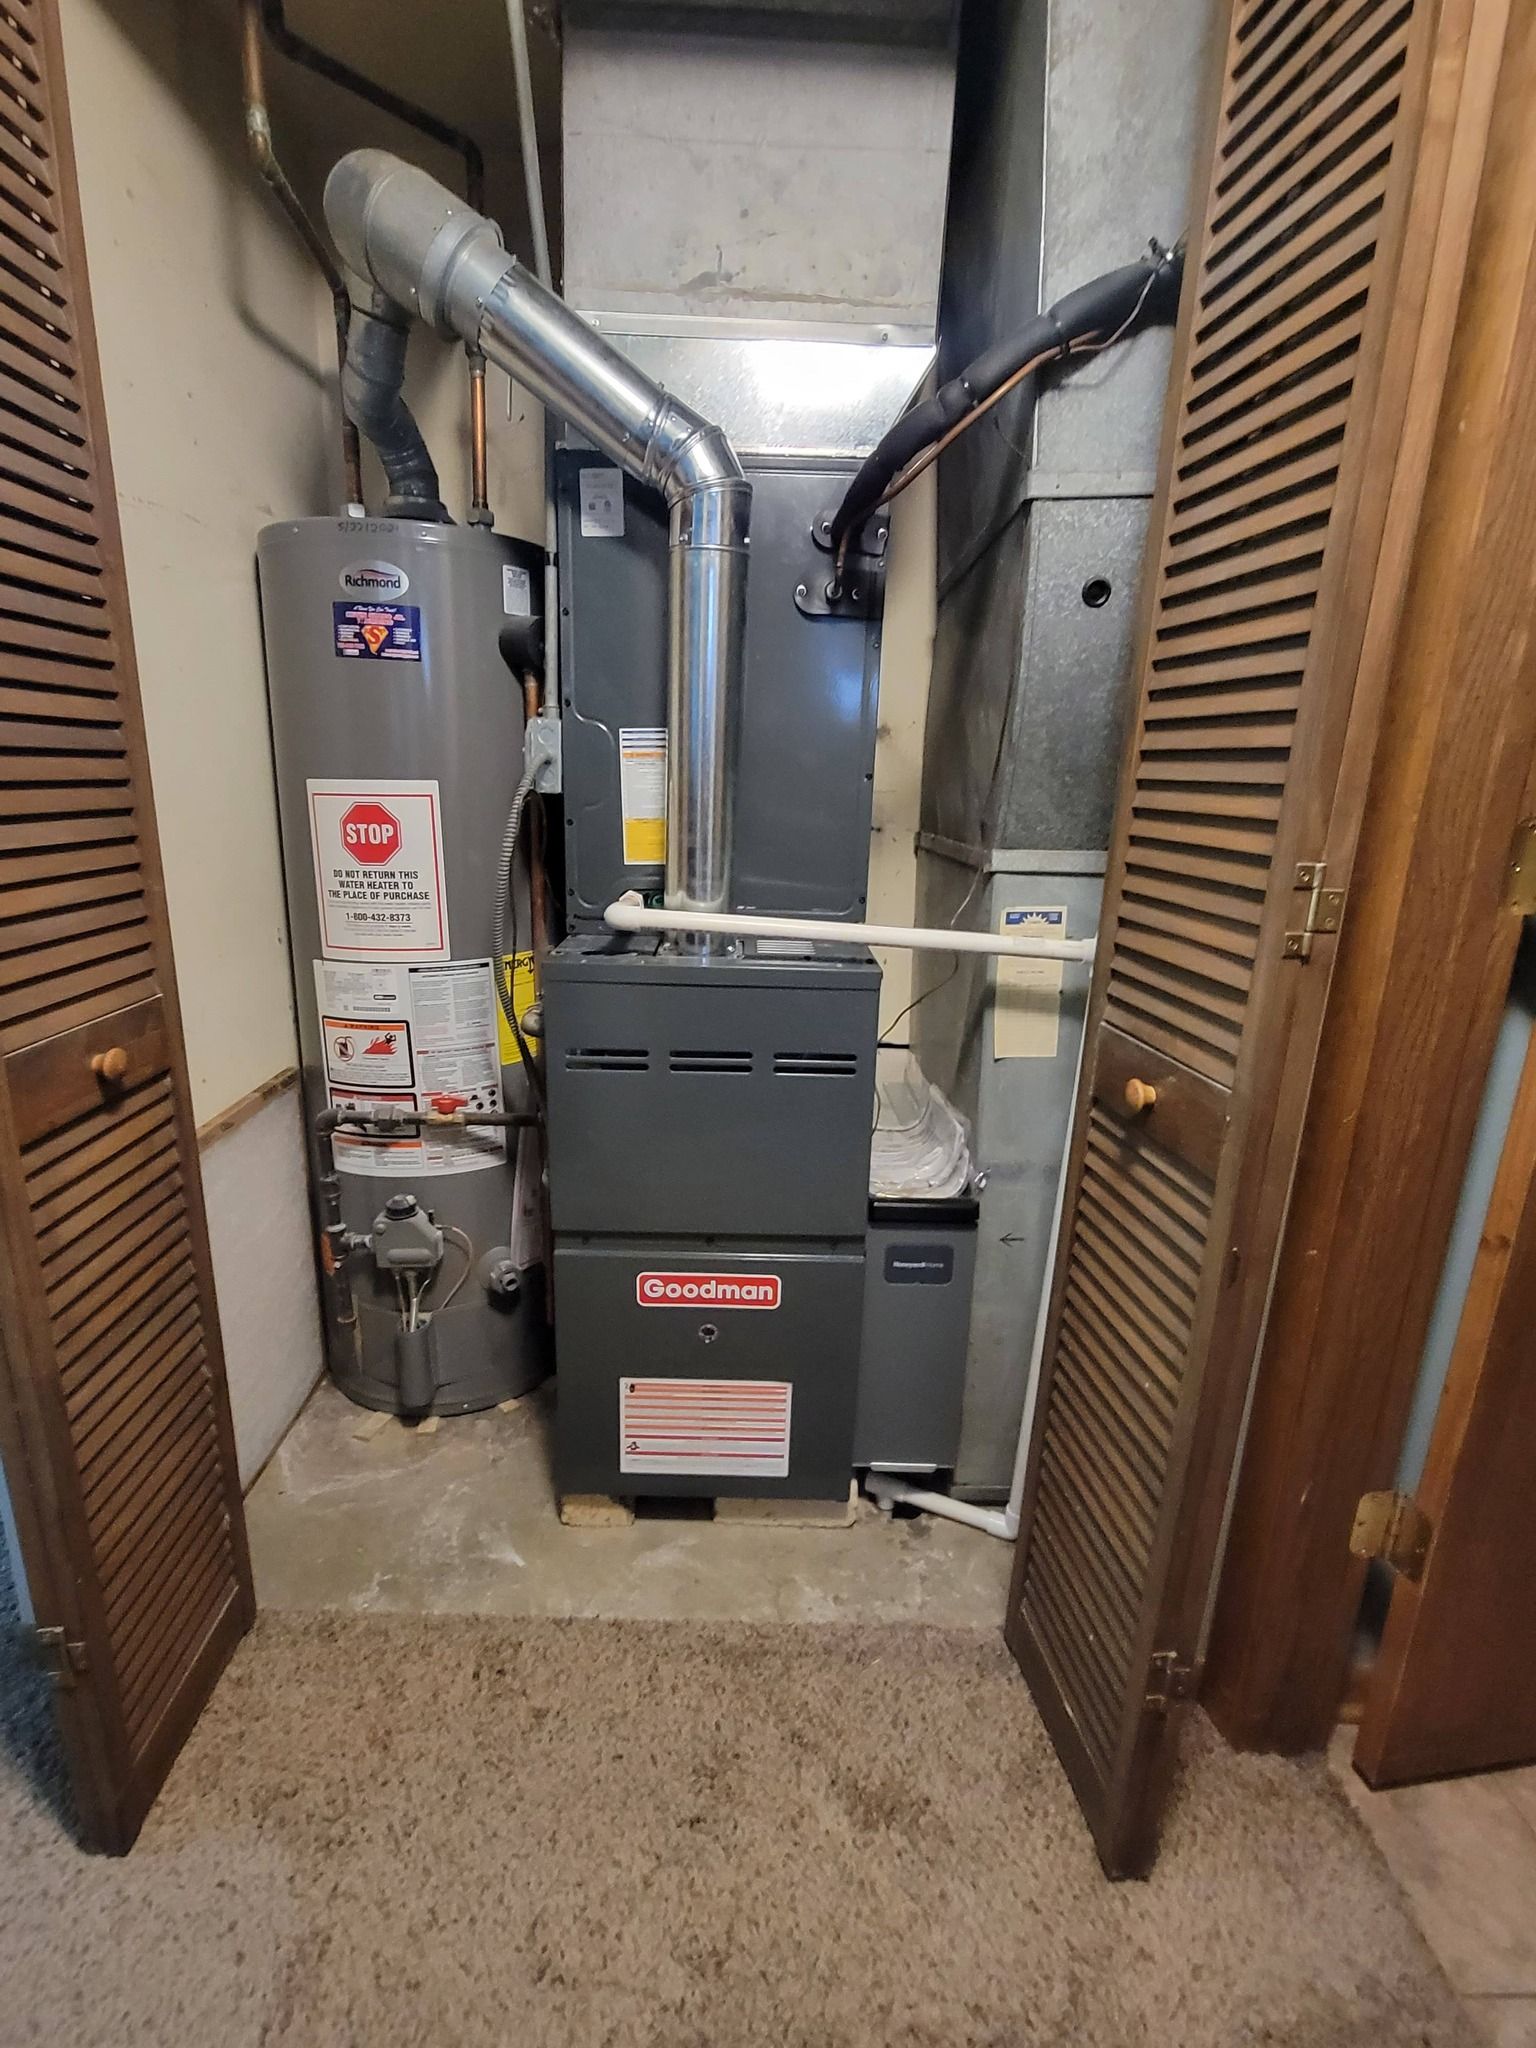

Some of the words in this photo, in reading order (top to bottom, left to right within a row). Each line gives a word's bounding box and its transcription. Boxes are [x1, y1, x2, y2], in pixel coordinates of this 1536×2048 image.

[345, 574, 400, 589] Richmond
[346, 823, 394, 845] STOP
[333, 869, 342, 878] DO
[345, 870, 360, 879] NOT
[363, 870, 396, 879] RETURN
[398, 871, 419, 880] THIS
[339, 880, 365, 890] WATER
[367, 881, 400, 890] HEATER
[402, 881, 414, 890] TO
[328, 889, 342, 899] THE
[343, 890, 367, 900] PLACE
[370, 891, 381, 900] OF
[383, 891, 430, 901] PURCHASE
[345, 912, 411, 922] 1-800-432-8373
[643, 1278, 773, 1301] Goodman
